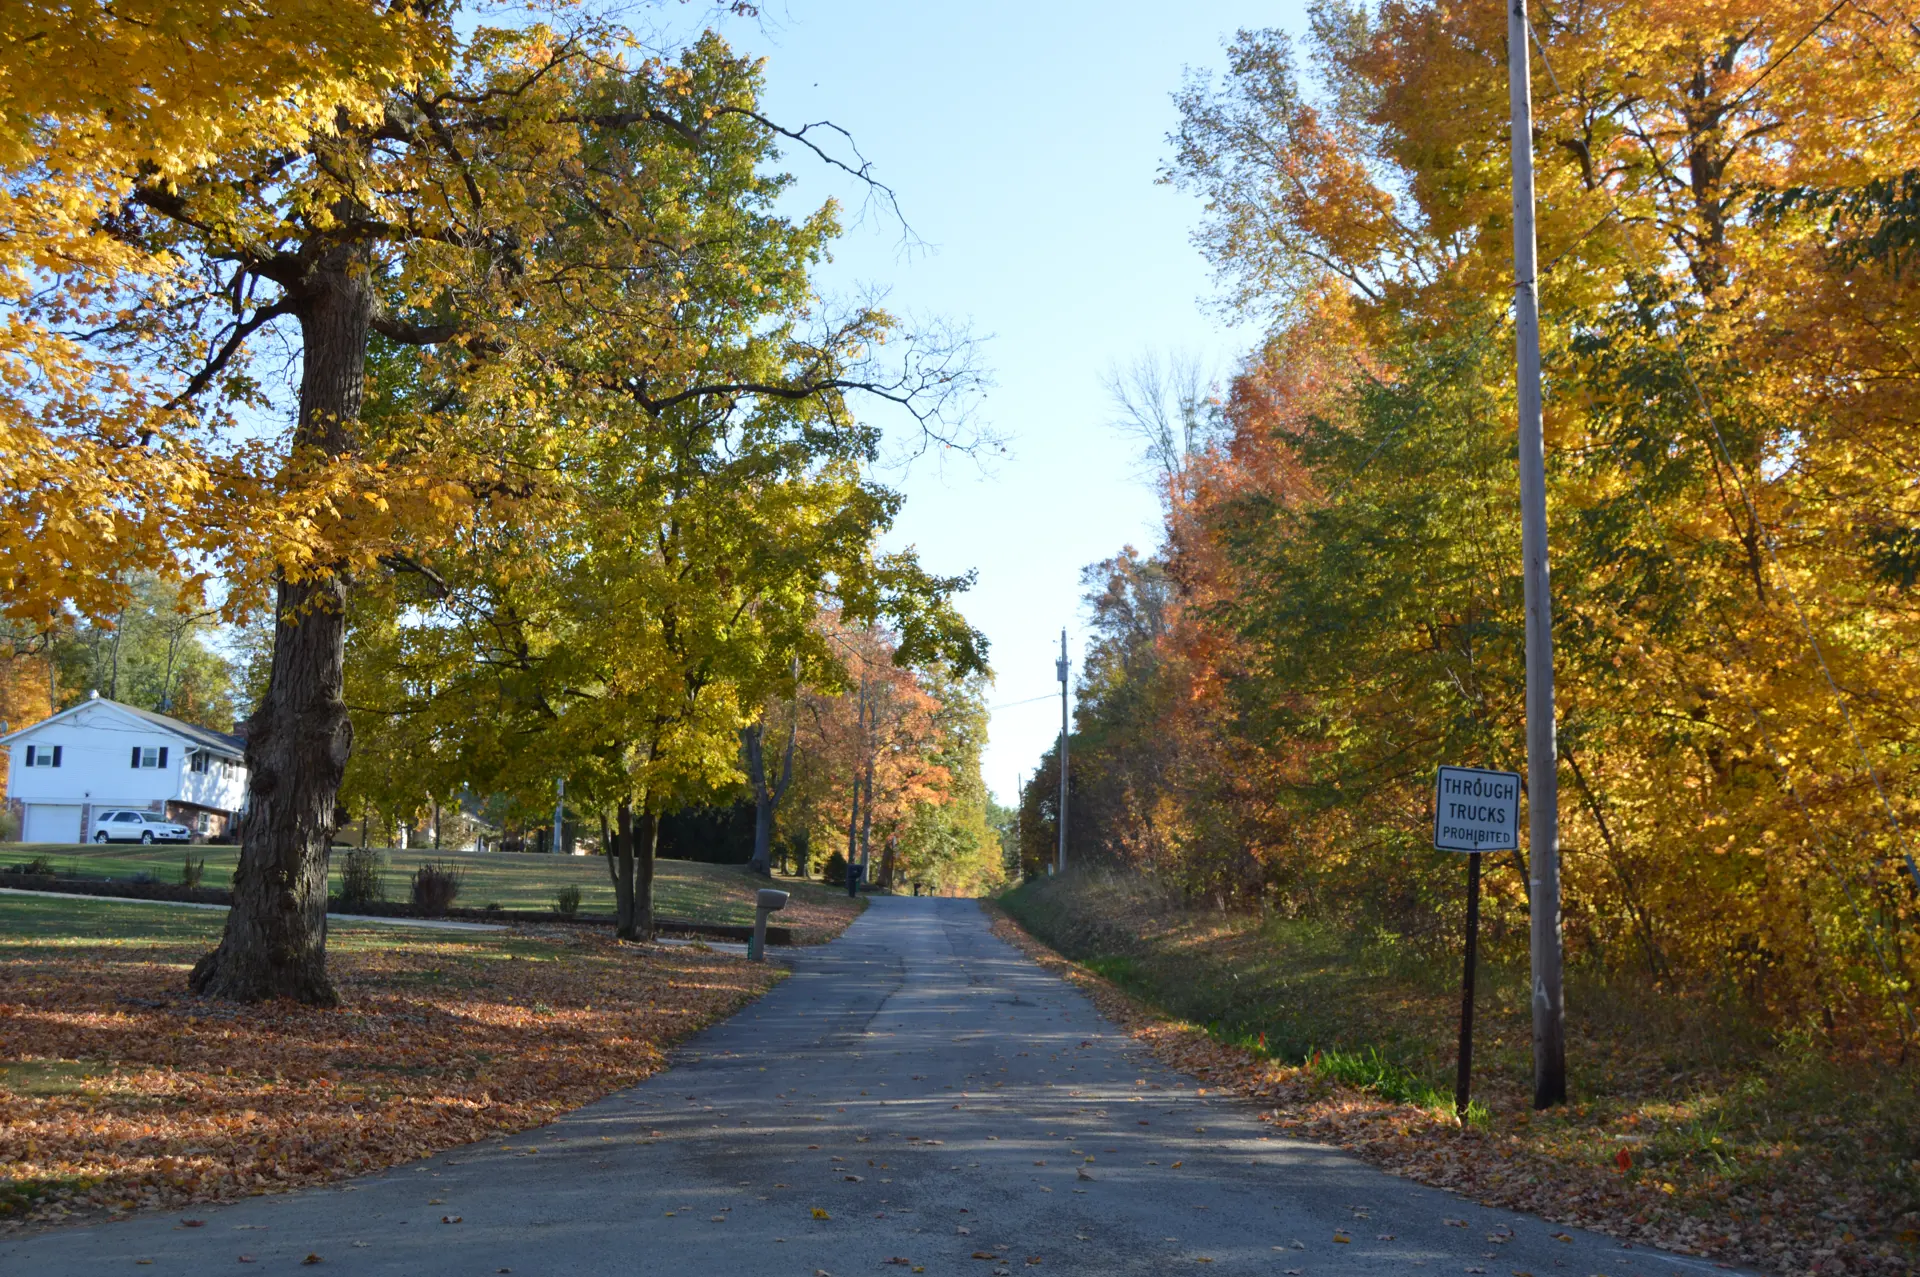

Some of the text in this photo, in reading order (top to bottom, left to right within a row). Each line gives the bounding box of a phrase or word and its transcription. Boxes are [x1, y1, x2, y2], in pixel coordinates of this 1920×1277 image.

[1444, 778, 1513, 800] THROUGH
[1449, 803, 1505, 823] TRUCKS
[1443, 826, 1510, 843] PROHIBITED
